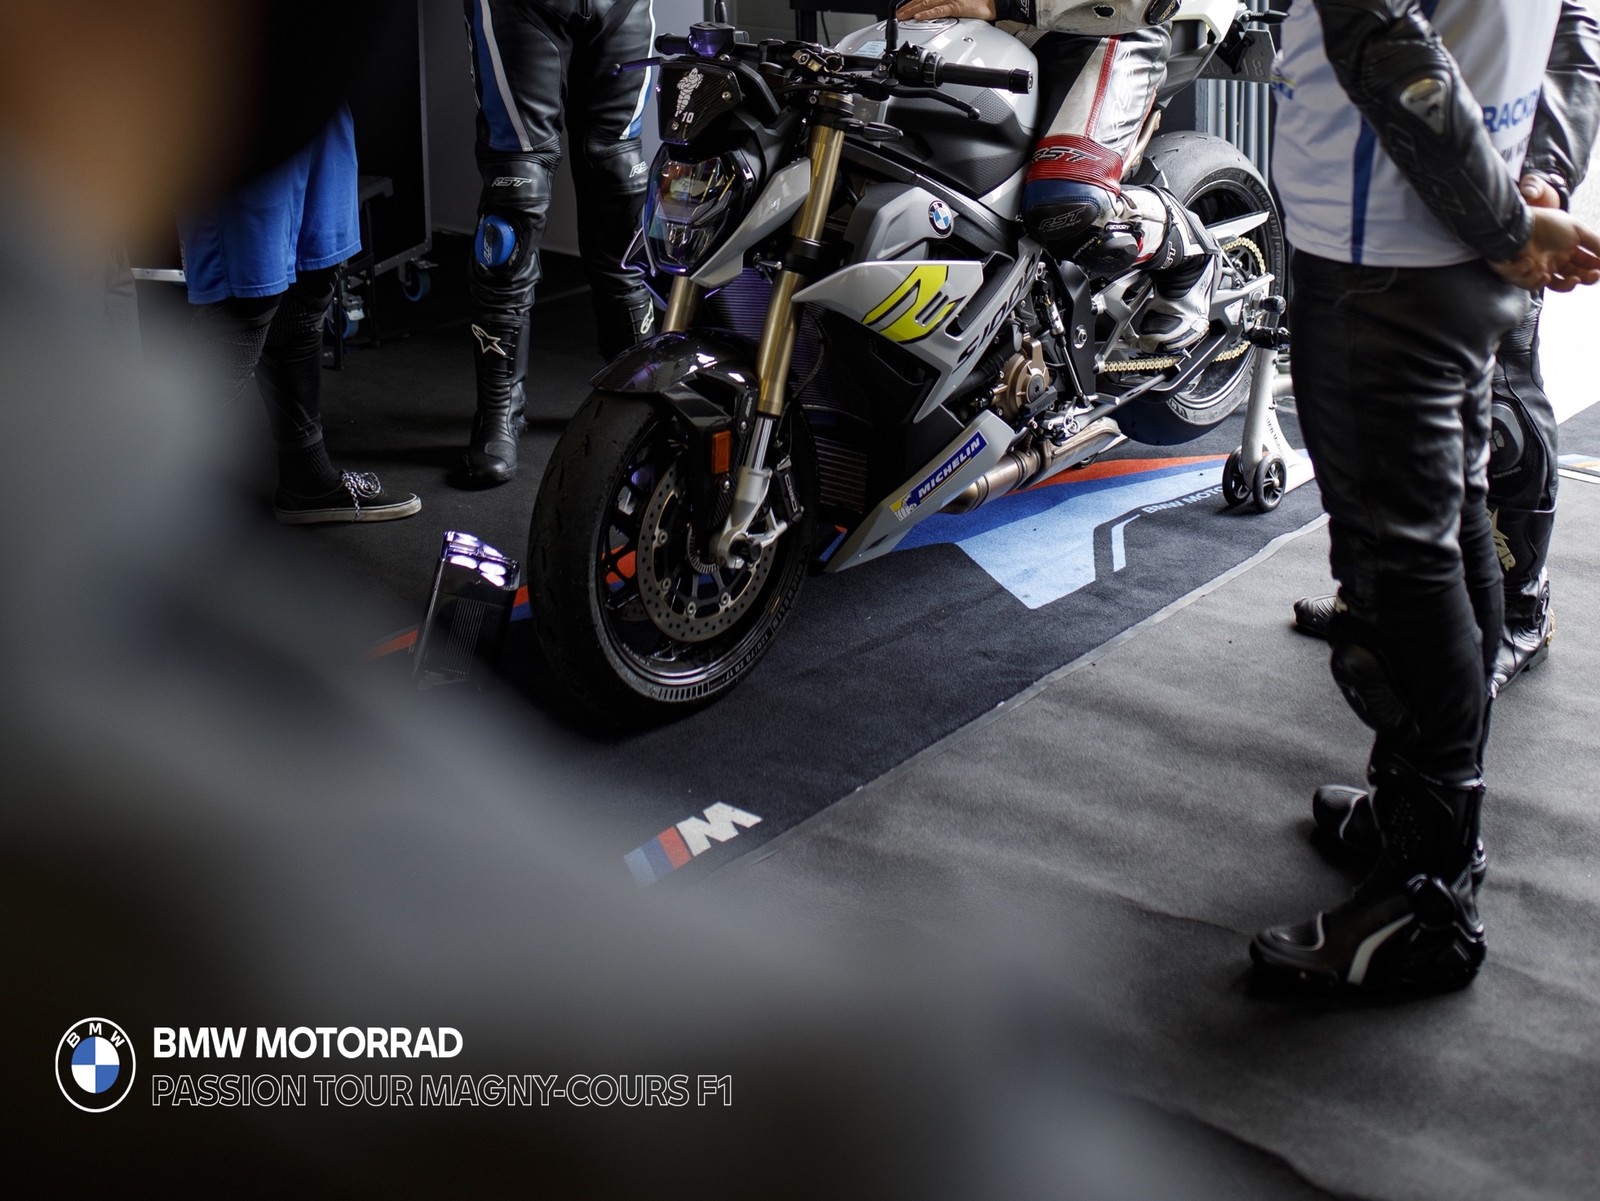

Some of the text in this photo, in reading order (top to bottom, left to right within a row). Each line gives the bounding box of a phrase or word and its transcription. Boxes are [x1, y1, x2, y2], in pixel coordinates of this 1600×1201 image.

[681, 111, 695, 123] 10
[491, 176, 533, 188] RST
[1038, 206, 1087, 230] RST
[917, 437, 982, 499] MICHELIN
[1141, 500, 1185, 515] BMW
[745, 634, 770, 662] 120/70
[675, 801, 763, 857] M
